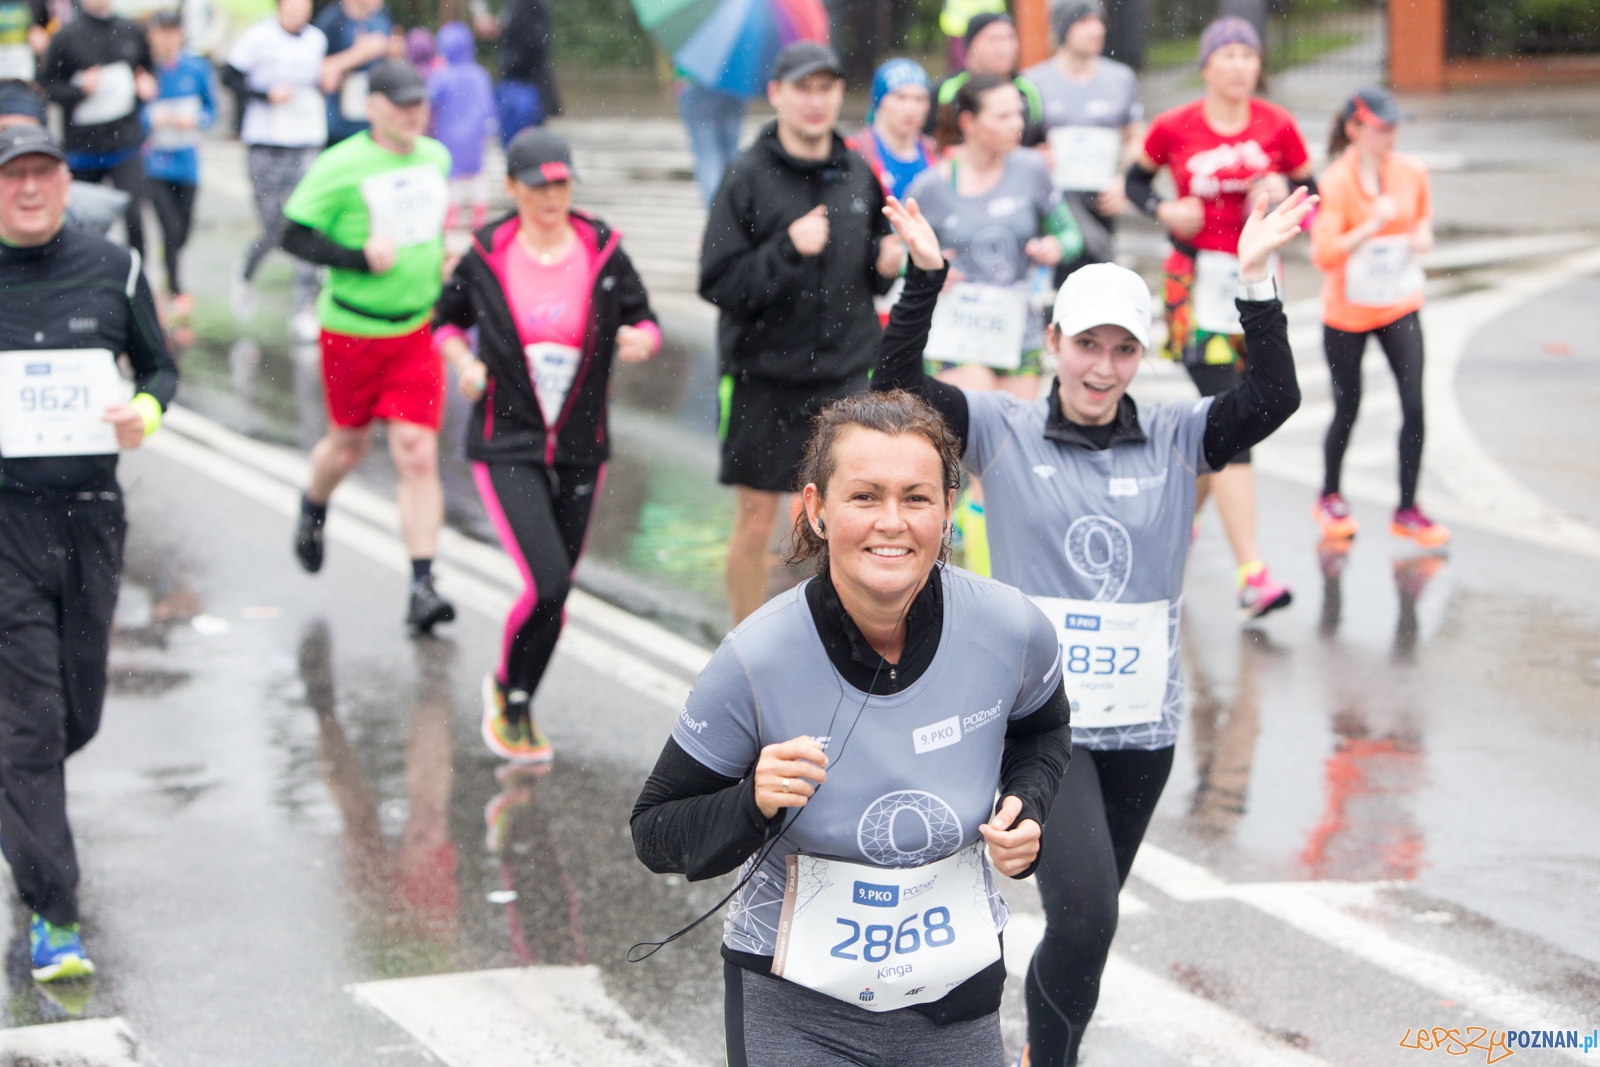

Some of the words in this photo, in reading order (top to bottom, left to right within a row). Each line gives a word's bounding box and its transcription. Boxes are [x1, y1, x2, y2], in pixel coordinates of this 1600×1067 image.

[20, 384, 90, 412] 9621
[1065, 514, 1133, 603] 9
[830, 906, 956, 963] 2868
[877, 963, 913, 979] Kinga
